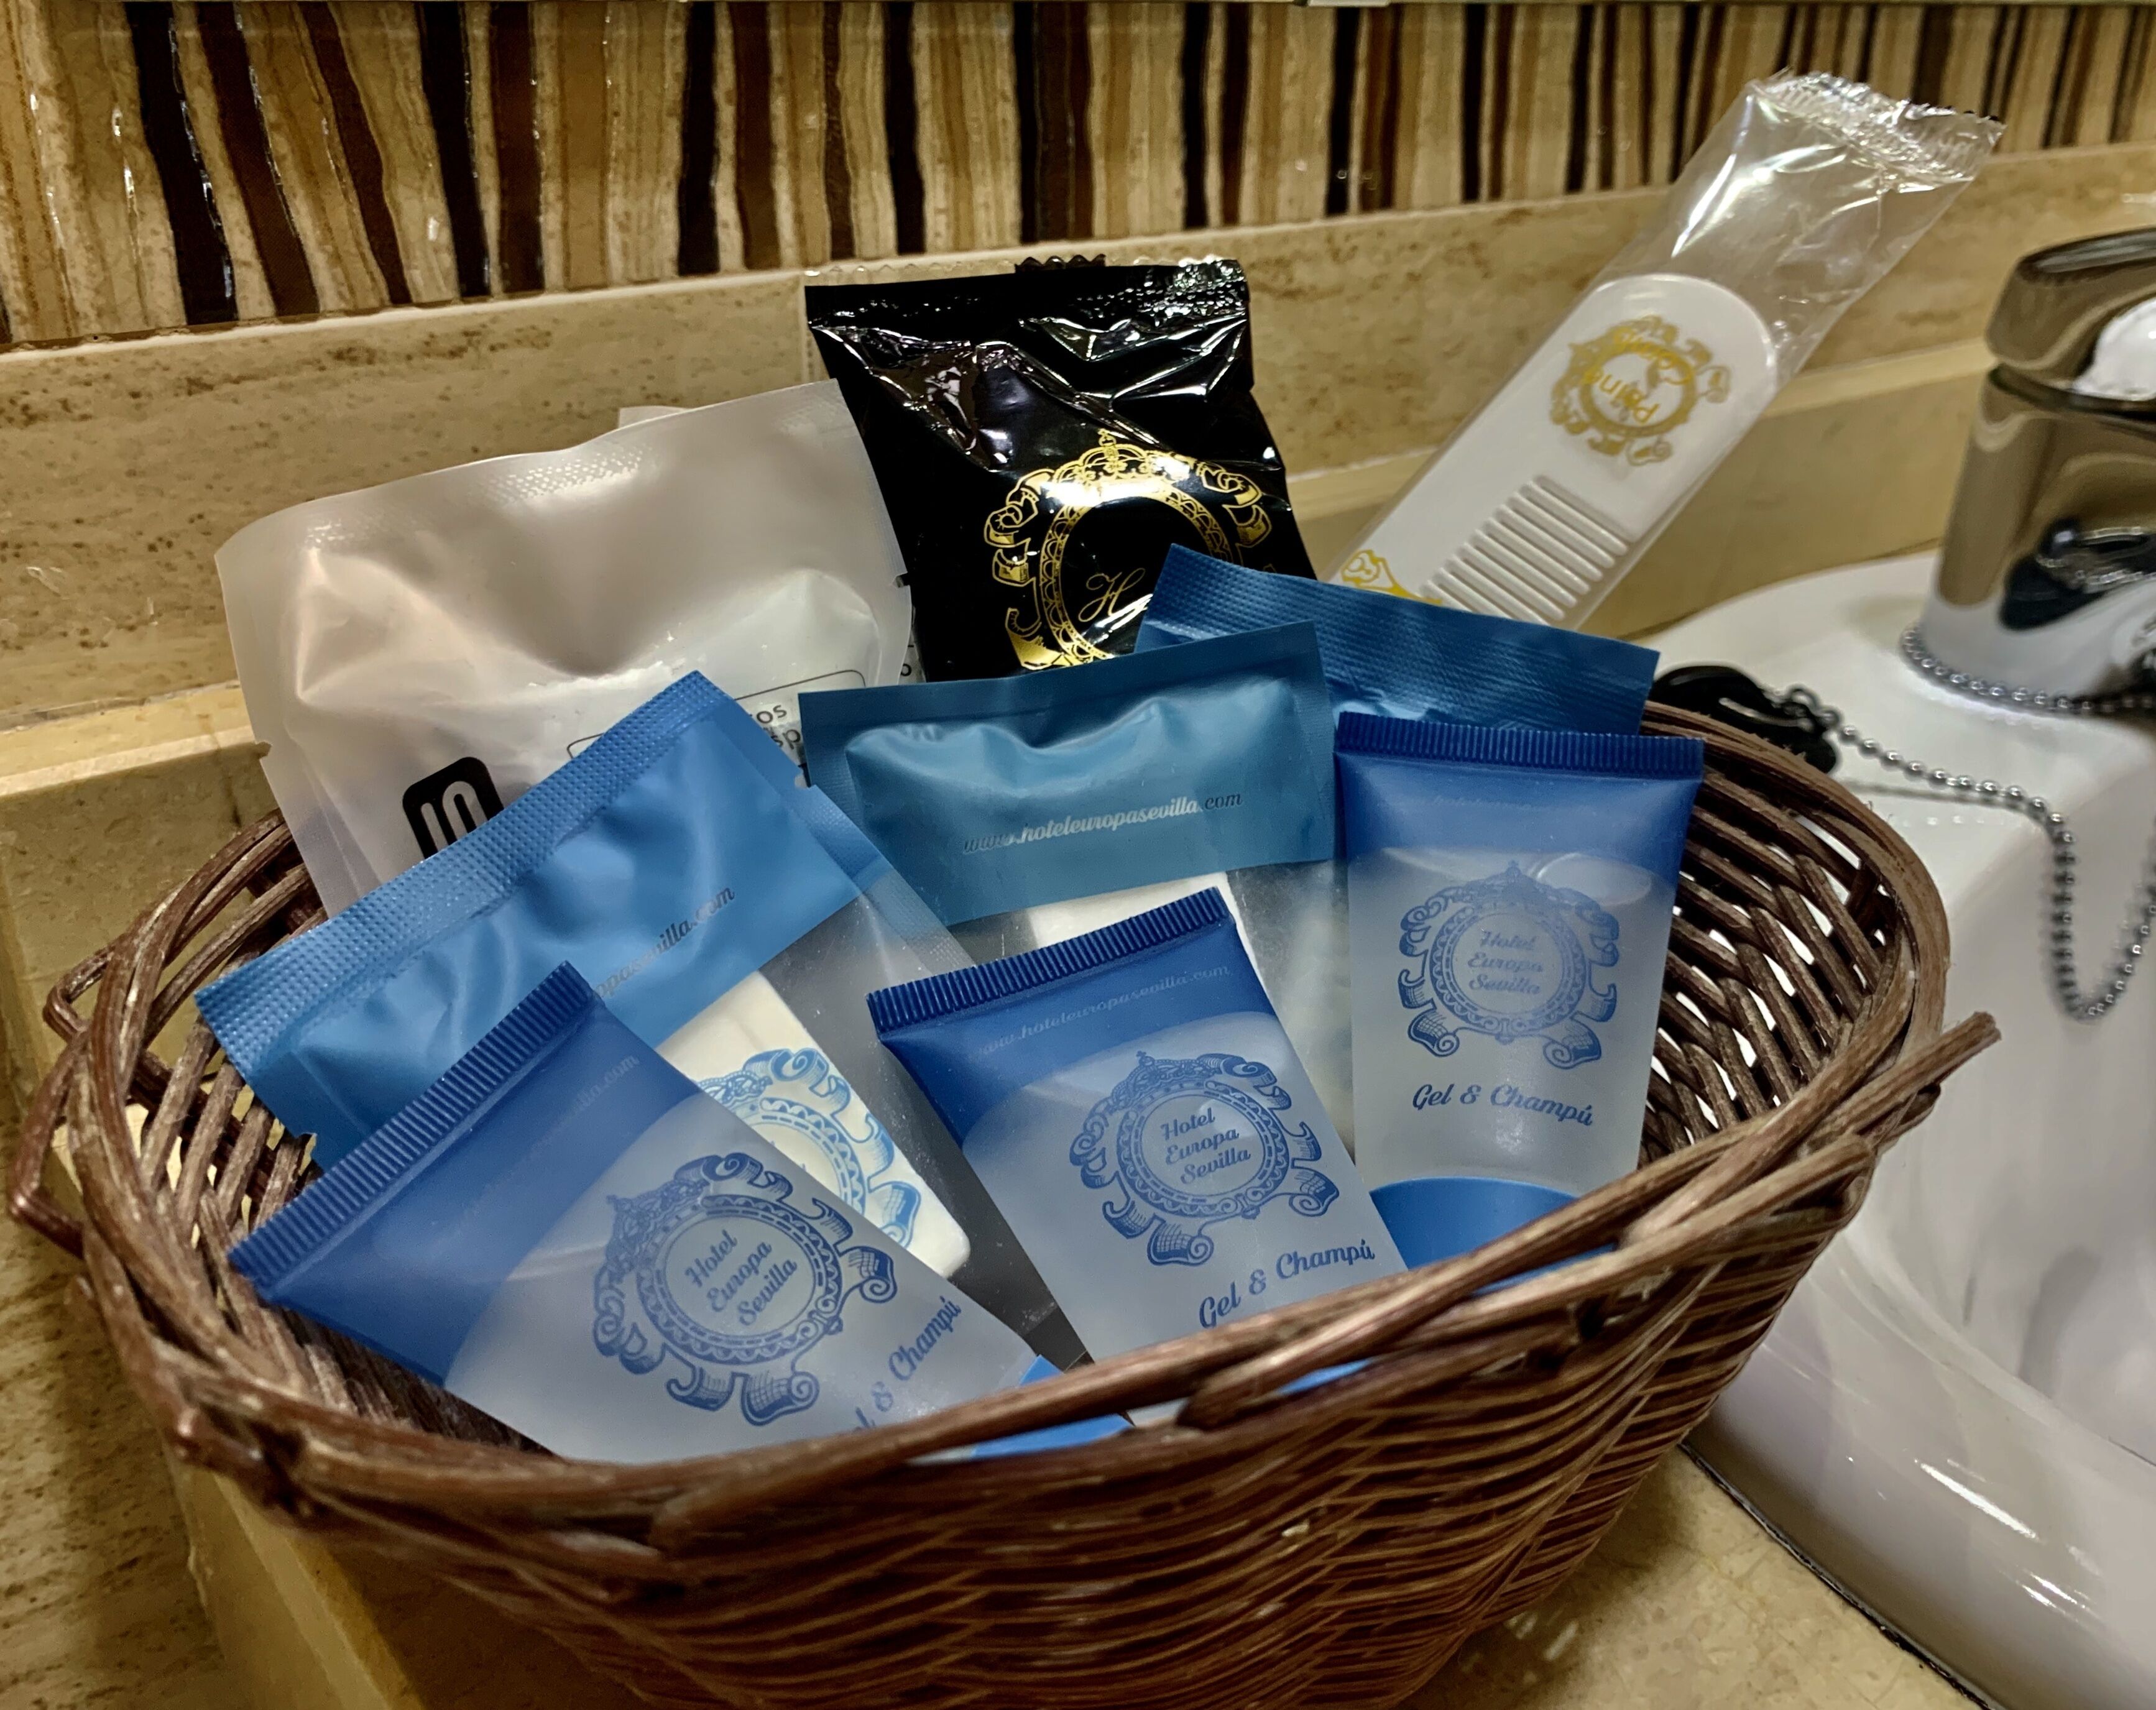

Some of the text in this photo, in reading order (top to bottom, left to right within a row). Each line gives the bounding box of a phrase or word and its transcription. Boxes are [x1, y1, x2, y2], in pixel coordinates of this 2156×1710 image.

[1078, 568, 1146, 622] H
[963, 793, 1243, 855] www.hoteleuropasevilla.com
[1467, 951, 1544, 973] Europa
[1161, 1107, 1215, 1141] Hotel
[1412, 1083, 1593, 1126] Gel & Champú
[1165, 1129, 1240, 1165] Europa
[1180, 1147, 1251, 1184] Sevilla
[685, 1229, 738, 1288] Hotel
[706, 1242, 772, 1313] Europa
[1199, 1238, 1375, 1329] Gel & Champú
[737, 1259, 798, 1326] Sevilla
[872, 1295, 962, 1412] & Champú
